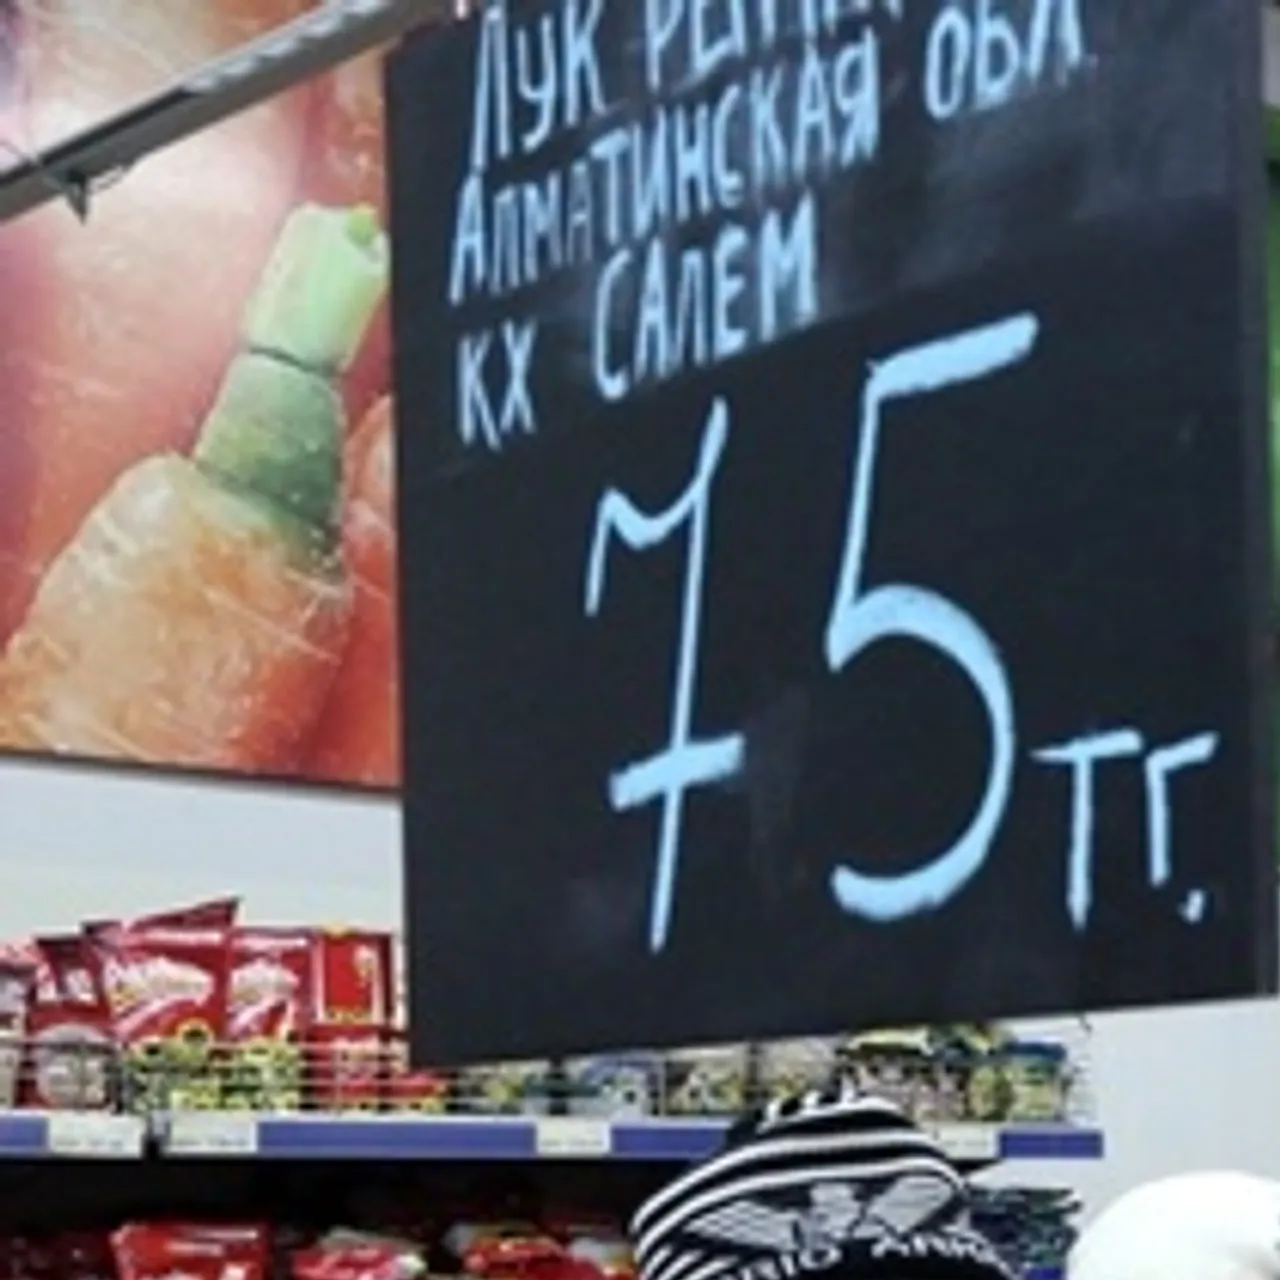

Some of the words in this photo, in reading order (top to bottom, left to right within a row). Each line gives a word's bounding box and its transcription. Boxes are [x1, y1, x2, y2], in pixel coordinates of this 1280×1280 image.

[450, 24, 880, 306] АЛМАТИНСКАЯ
[471, 0, 606, 170] ЛУК
[456, 316, 538, 452] КХ
[591, 190, 820, 401] САЛЕМ
[584, 312, 1040, 952] 75
